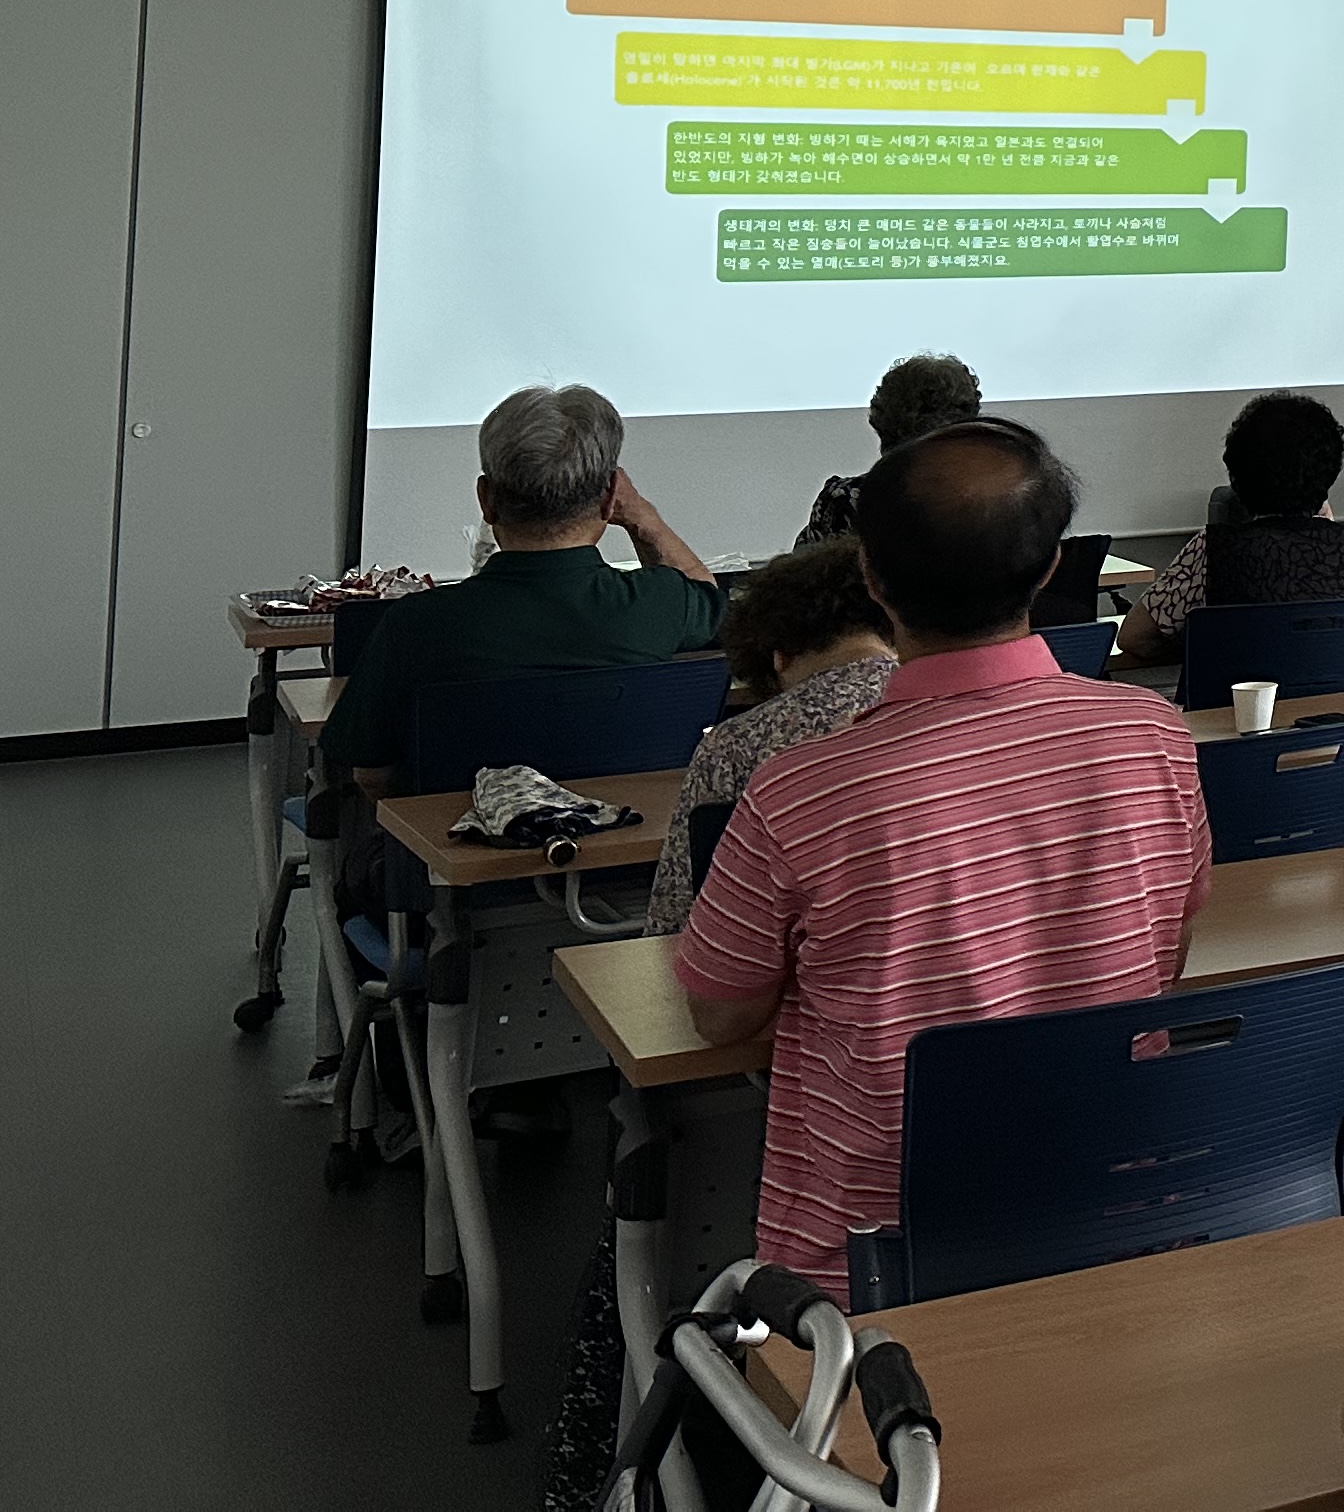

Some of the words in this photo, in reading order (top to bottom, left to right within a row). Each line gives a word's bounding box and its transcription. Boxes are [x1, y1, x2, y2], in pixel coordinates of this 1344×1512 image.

[673, 131, 732, 146] 한반도의
[737, 132, 766, 146] 지형
[772, 132, 804, 147] 변화:
[809, 133, 850, 147] 빙하기
[855, 134, 884, 148] 때는
[888, 134, 931, 148] 서해가
[935, 135, 989, 149] 육지였고
[994, 135, 1047, 149] 일본과도
[1052, 136, 1104, 149] 연결되어
[673, 150, 735, 165] 있었지만,
[740, 151, 784, 165] 빙하가
[788, 151, 817, 165] 녹아
[821, 151, 878, 166] 해수면이
[883, 152, 951, 166] 상승하면서
[956, 153, 971, 167] 약
[975, 153, 996, 167] 1만
[1001, 153, 1014, 167] 년
[1019, 153, 1046, 167] 전쯤
[1050, 154, 1090, 167] 지금과
[1093, 154, 1120, 167] 같은
[672, 169, 702, 183] 반도
[707, 169, 751, 184] 형태가
[756, 169, 844, 184] 갖춰졌습니다.
[723, 218, 781, 233] 생태계의
[787, 218, 819, 233] 변화:
[824, 218, 851, 233] 덩치
[856, 218, 872, 232] 큰
[875, 218, 917, 232] 매머드
[922, 218, 950, 232] 같은
[953, 217, 1008, 231] 동물들이
[1012, 217, 1069, 231] 사라지고,
[1072, 217, 1112, 230] 토끼나
[1115, 216, 1167, 230] 사슴처럼
[723, 237, 767, 252] 빠르고
[772, 237, 801, 252] 작은
[806, 237, 862, 251] 짐승들이
[867, 236, 953, 251] 늘어났습니다.
[957, 236, 1012, 250] 식물군도
[1016, 234, 1082, 249] 침엽수에서
[1085, 234, 1138, 248] 활엽수로
[1142, 233, 1180, 247] 바뀌며
[723, 257, 752, 271] 먹을
[756, 257, 771, 271] 수
[776, 256, 805, 270] 있는
[810, 255, 884, 270] 열매(도토리
[889, 254, 922, 270] 등)가
[925, 254, 1011, 268] 풍부해졌지요.
